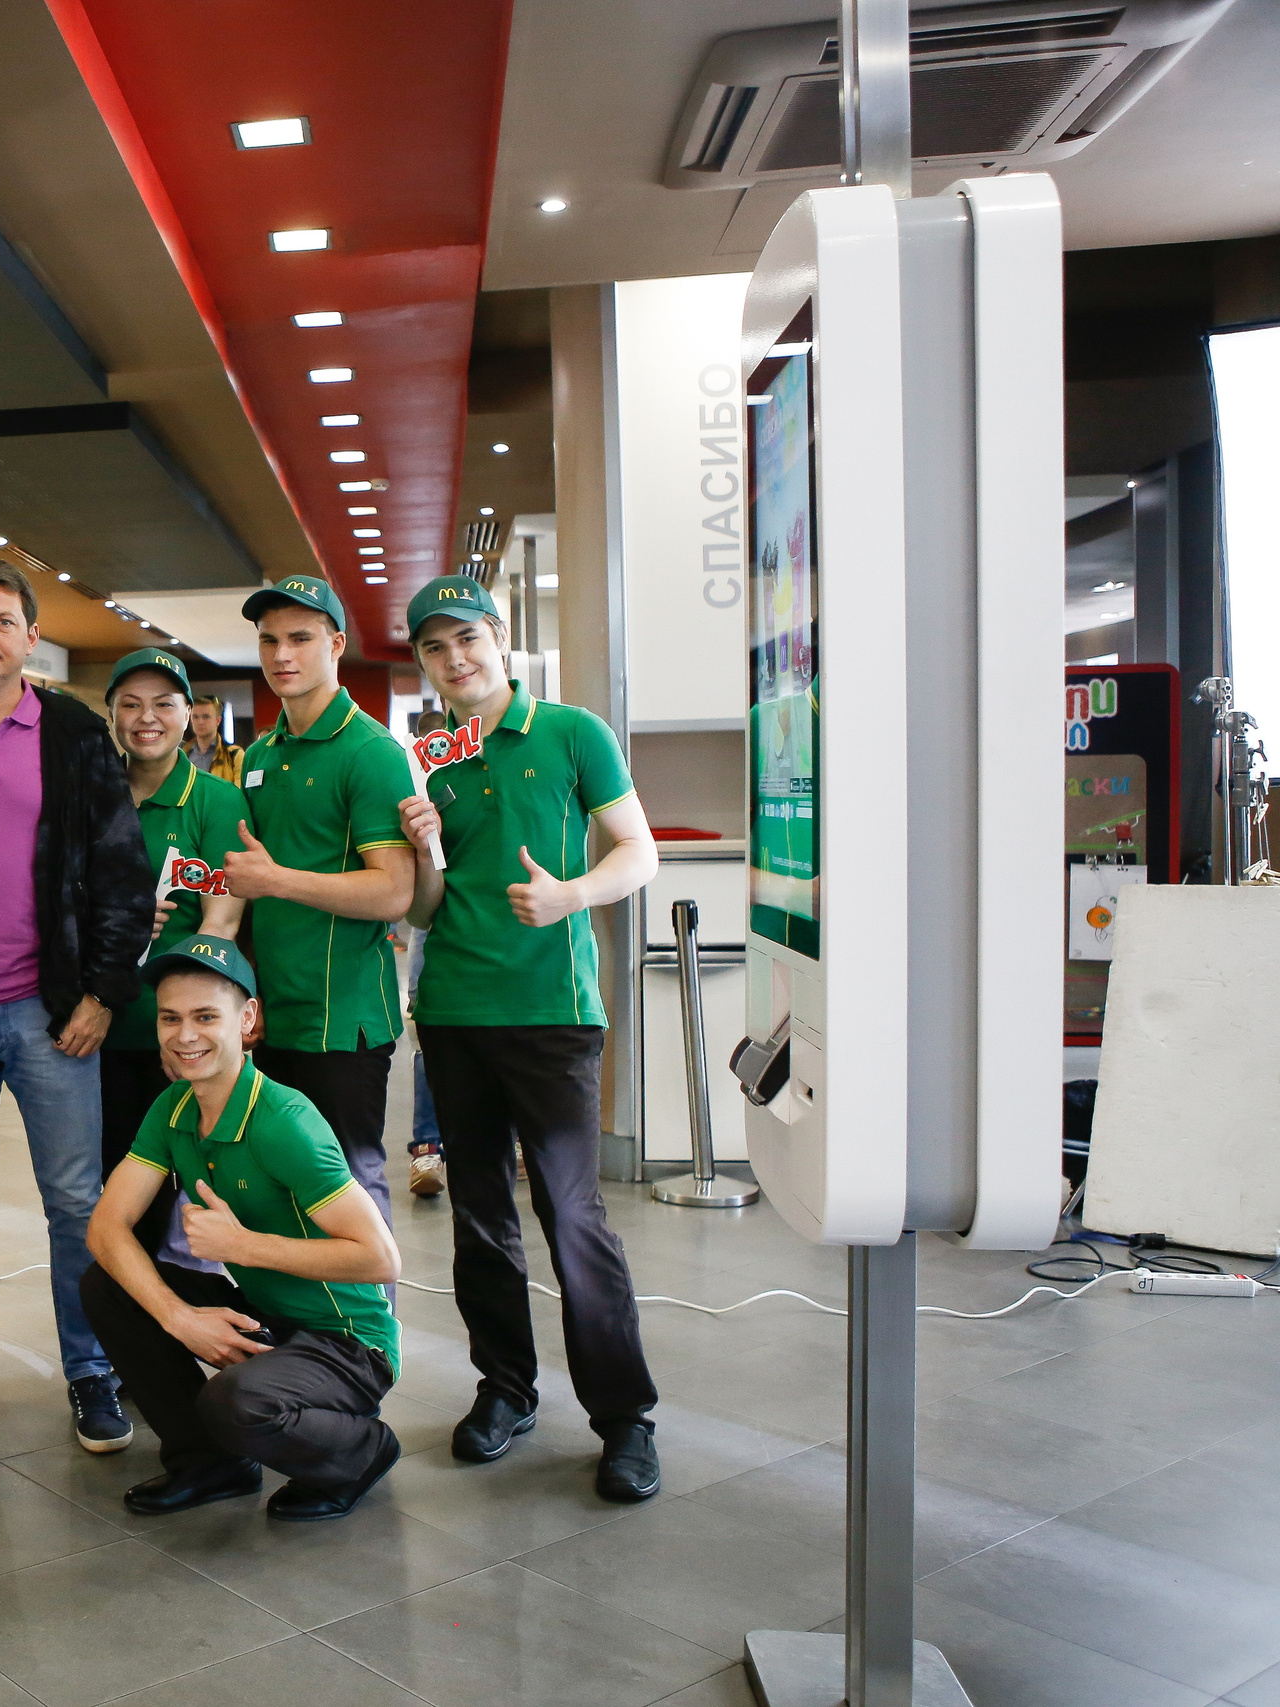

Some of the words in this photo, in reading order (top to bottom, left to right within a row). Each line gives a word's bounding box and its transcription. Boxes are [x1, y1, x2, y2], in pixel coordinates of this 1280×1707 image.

[698, 363, 742, 609] СПАСИБО
[1066, 777, 1130, 796] аски
[172, 858, 228, 896] ГОЛ
